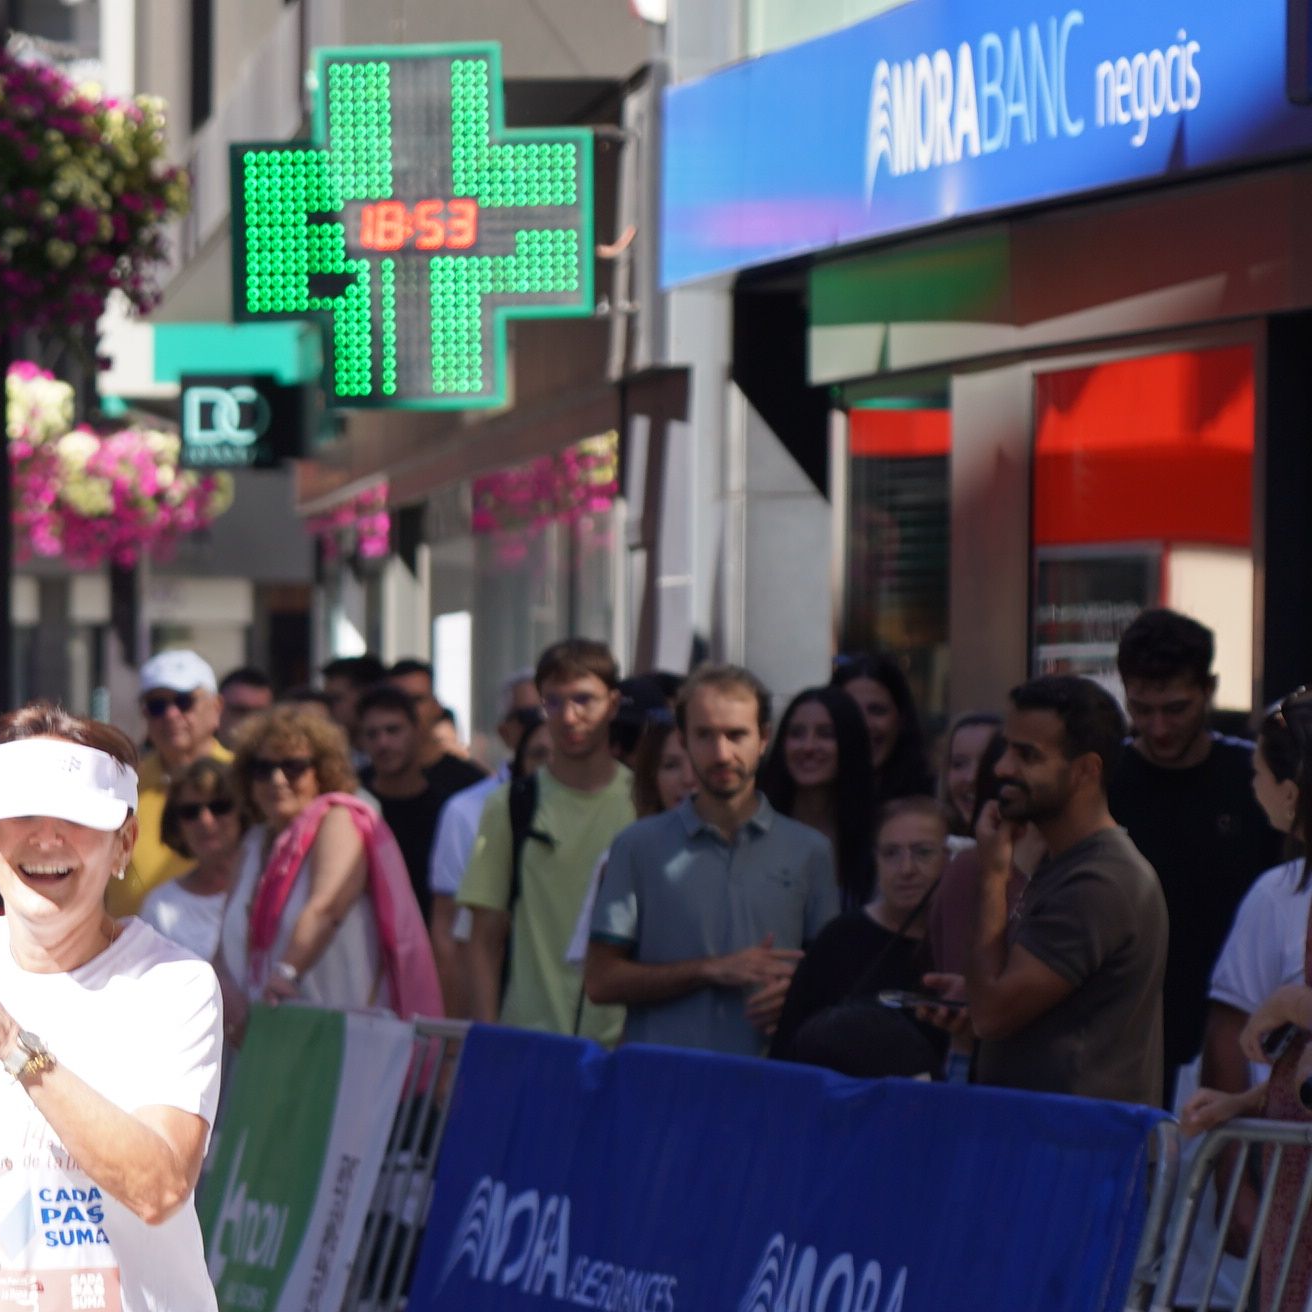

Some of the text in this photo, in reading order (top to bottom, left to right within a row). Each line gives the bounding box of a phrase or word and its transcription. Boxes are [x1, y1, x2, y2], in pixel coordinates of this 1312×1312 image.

[1095, 27, 1202, 148] negocis
[360, 198, 477, 251] 18:53
[183, 385, 258, 447] DC
[39, 1186, 102, 1202] CADA
[40, 1204, 105, 1224] PAS
[45, 1227, 110, 1247] SUMA
